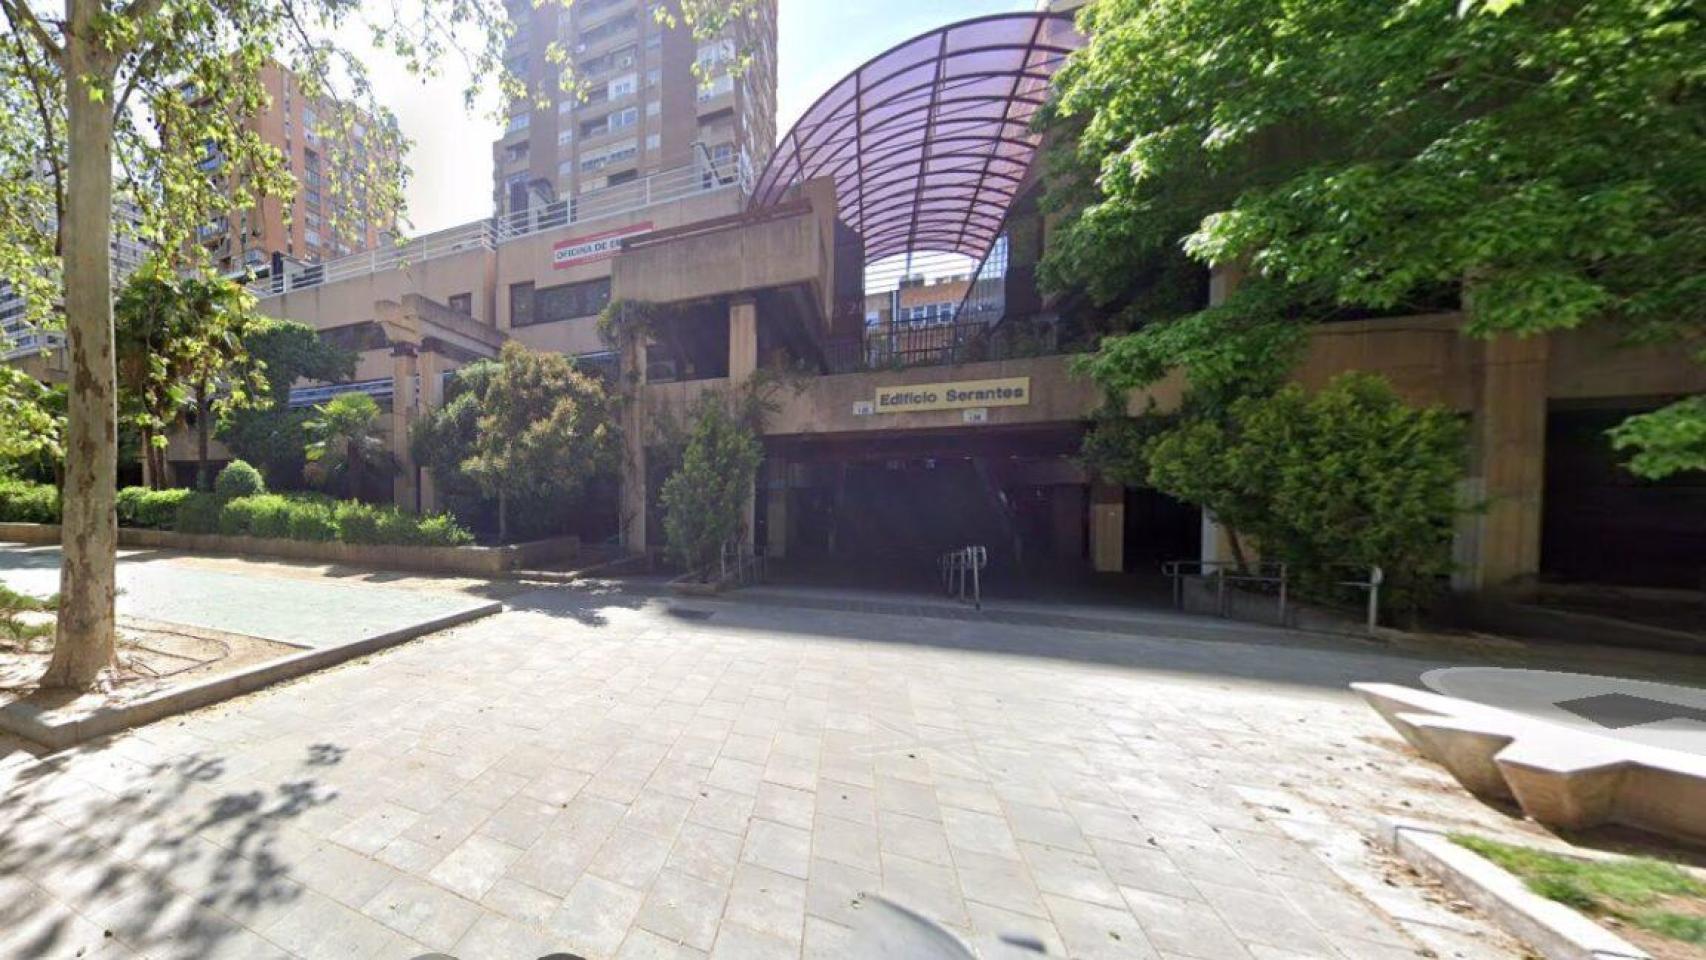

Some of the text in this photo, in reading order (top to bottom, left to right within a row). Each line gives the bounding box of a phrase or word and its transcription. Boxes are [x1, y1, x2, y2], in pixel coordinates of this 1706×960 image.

[594, 240, 606, 251] DE
[879, 387, 1024, 406] Edificio Serantes
